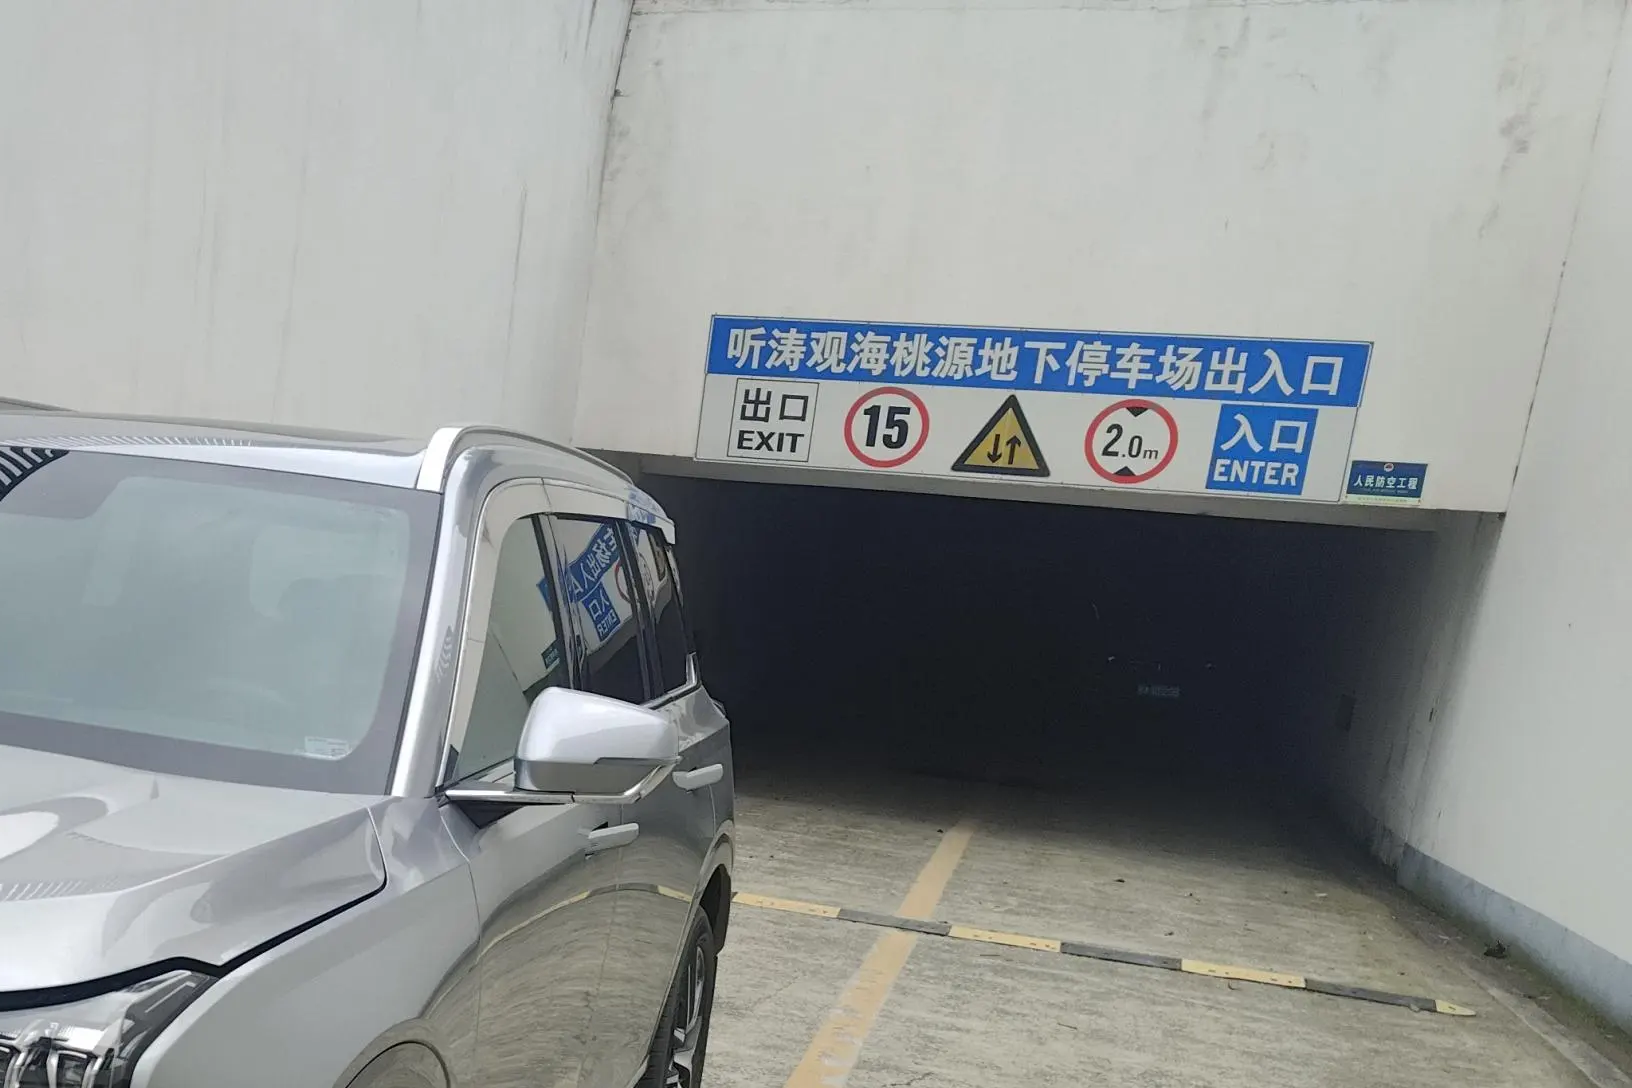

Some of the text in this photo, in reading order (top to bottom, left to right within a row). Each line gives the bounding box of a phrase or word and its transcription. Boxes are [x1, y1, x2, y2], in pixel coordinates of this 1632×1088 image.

[726, 326, 1345, 396] 听涛观海桃源地下停车场出入口
[739, 387, 809, 423] 出口
[736, 429, 805, 453] EXIT
[863, 404, 911, 449] 15
[1101, 423, 1159, 461] 2.0m
[1220, 413, 1308, 453] 入口
[1212, 458, 1299, 487] ENTER
[1353, 474, 1419, 490] 人民防空工程
